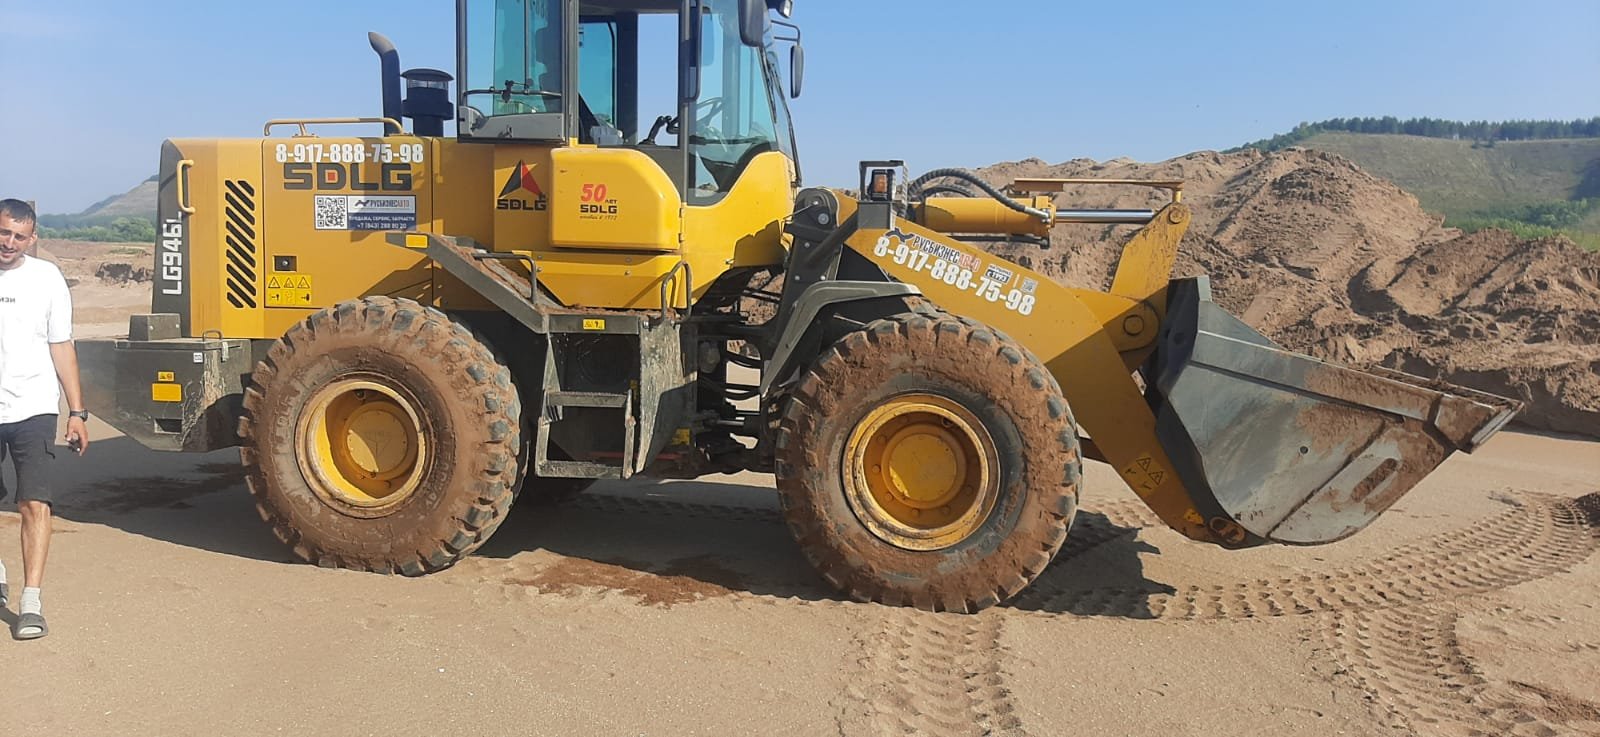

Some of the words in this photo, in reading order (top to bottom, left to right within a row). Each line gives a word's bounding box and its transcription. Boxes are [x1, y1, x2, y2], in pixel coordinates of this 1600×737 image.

[275, 143, 423, 163] 8-917-888-75-98
[283, 162, 412, 190] SDLG
[580, 183, 607, 202] 50
[496, 199, 547, 211] SDLG
[580, 204, 617, 214] SDLG
[162, 211, 182, 295] LG946L
[873, 236, 1036, 316] 8-917-888-75-98
